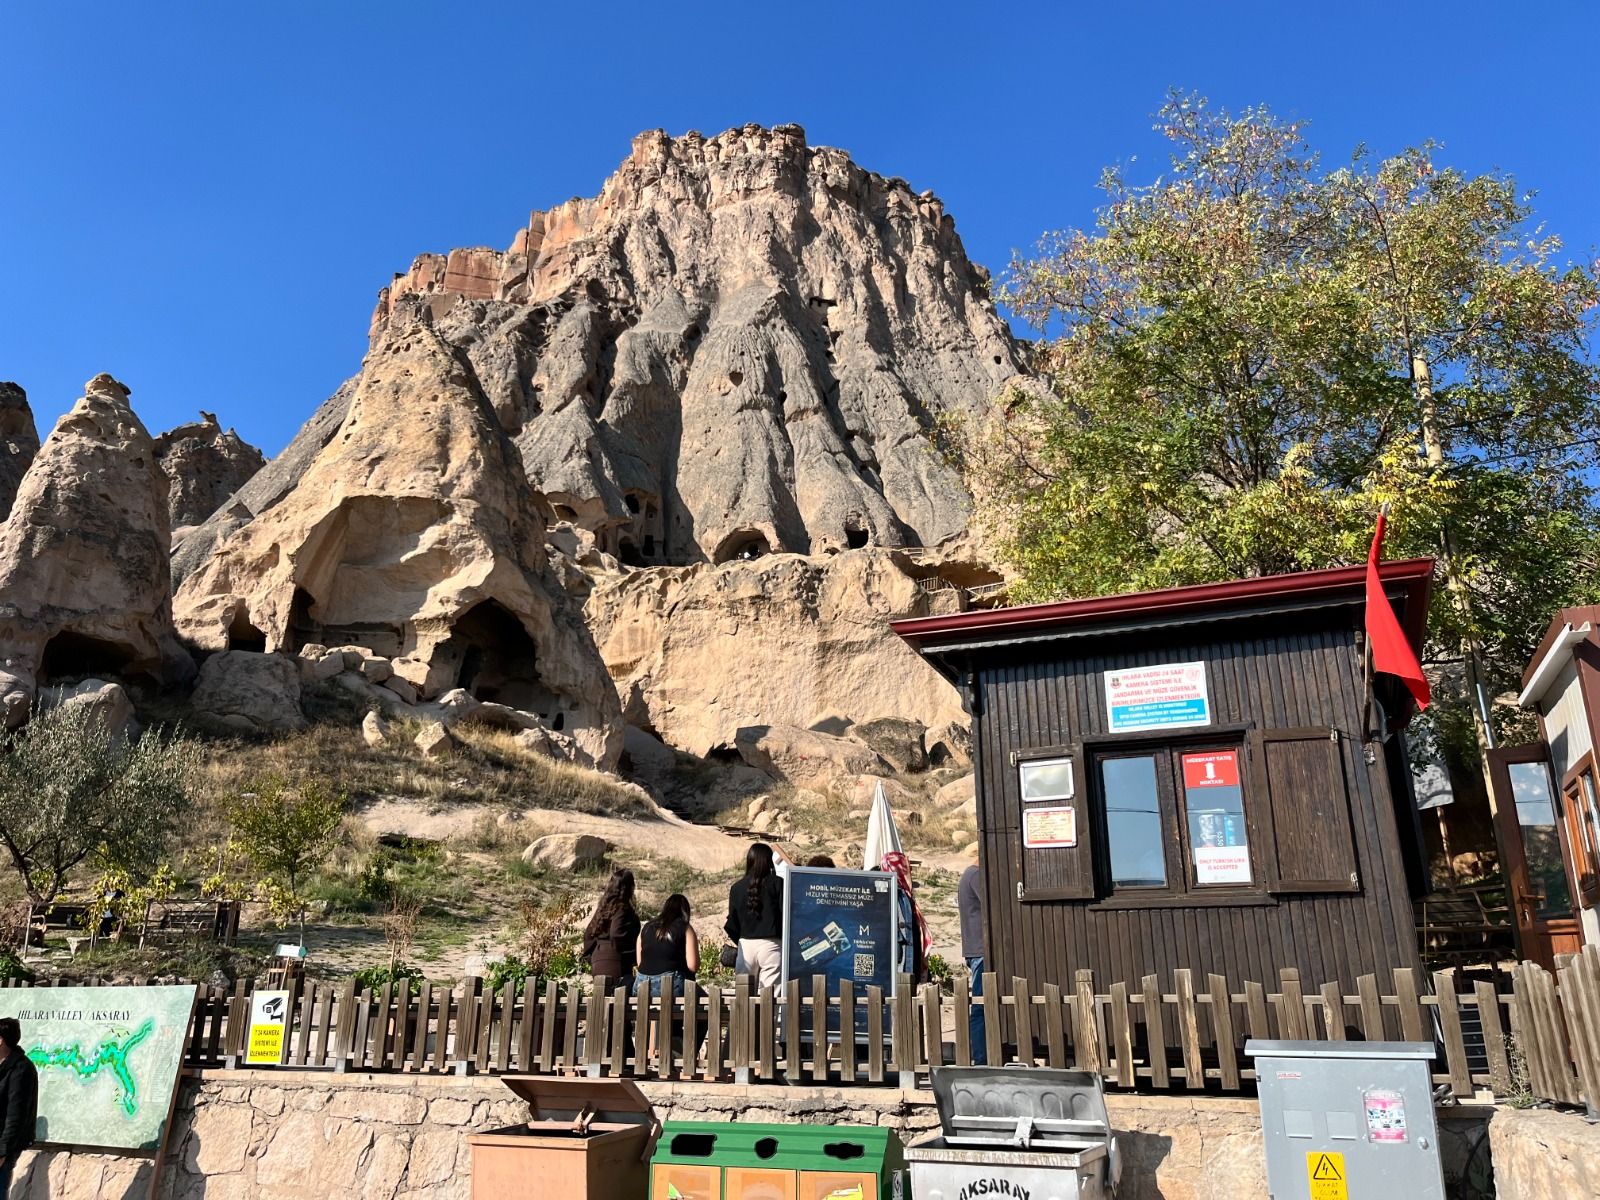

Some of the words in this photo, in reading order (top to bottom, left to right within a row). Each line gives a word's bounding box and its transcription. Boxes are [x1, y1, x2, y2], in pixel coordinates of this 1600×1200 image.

[829, 885, 860, 893] MÜZEKART
[862, 886, 870, 894] İLE
[859, 924, 870, 936] M
[18, 1010, 49, 1020] IHLARA
[51, 1010, 82, 1020] VALLEY
[89, 1010, 130, 1020] AKSARAY
[959, 1178, 1030, 1200] AKSARAY
